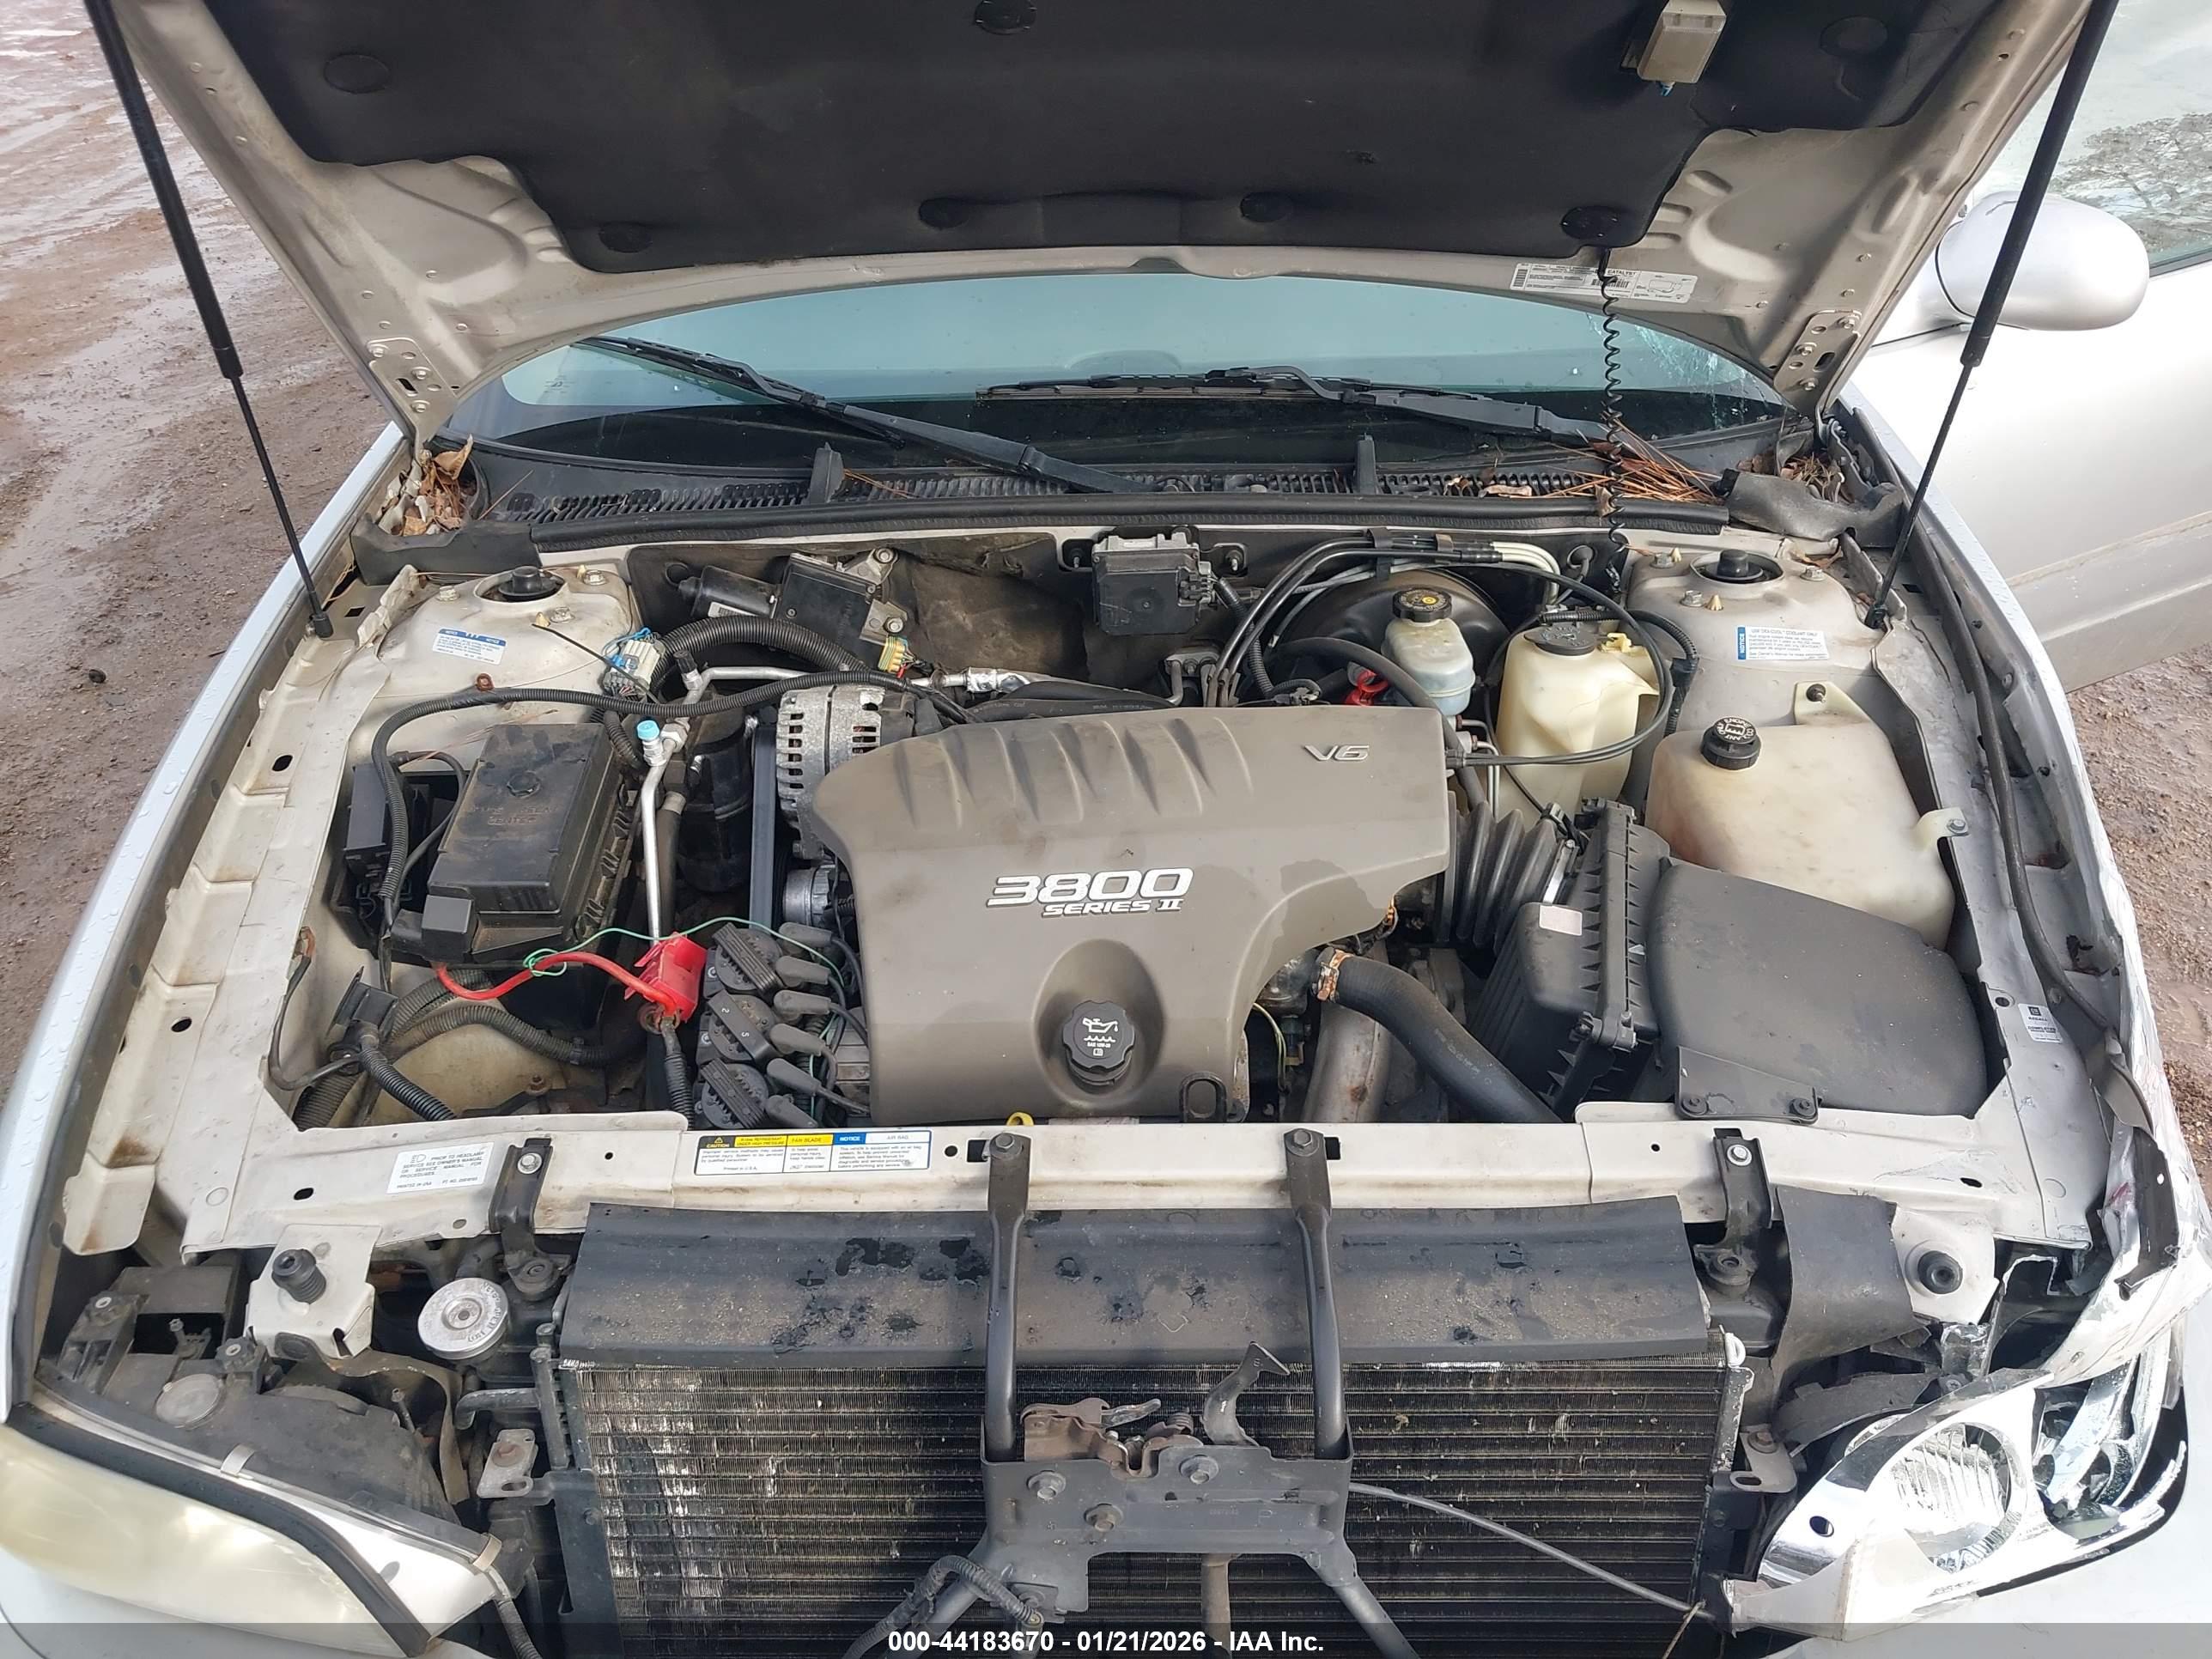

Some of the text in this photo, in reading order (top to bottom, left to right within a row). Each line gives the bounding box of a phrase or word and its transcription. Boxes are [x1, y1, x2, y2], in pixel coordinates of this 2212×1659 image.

[1723, 718, 1752, 727] ENGINE
[1724, 728, 1753, 740] COOLANT
[1303, 744, 1370, 761] V6
[987, 867, 1194, 908] 3800
[1042, 899, 1184, 918] SERIES II
